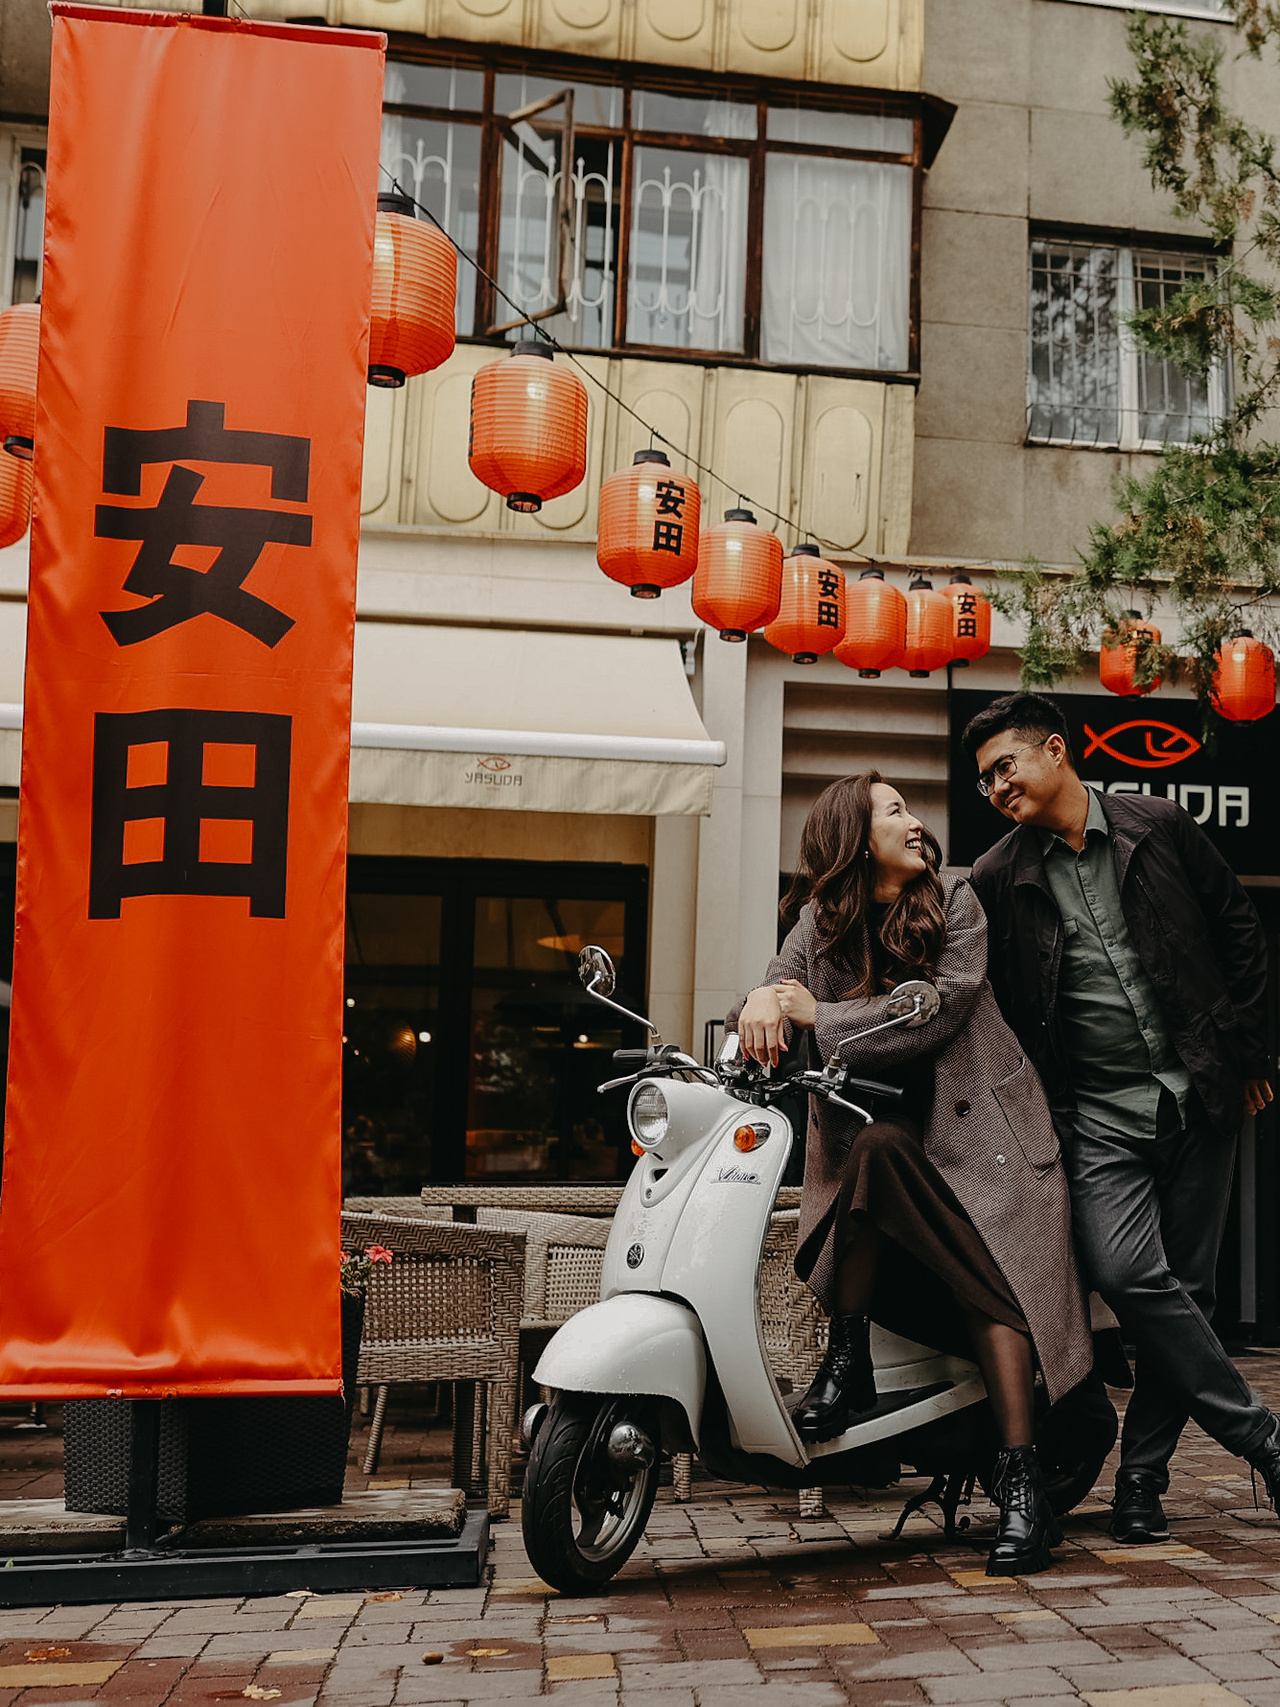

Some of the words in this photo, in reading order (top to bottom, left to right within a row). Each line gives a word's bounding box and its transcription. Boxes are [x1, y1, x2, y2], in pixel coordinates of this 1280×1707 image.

[652, 480, 686, 556] 安田
[817, 569, 840, 630] 安田
[956, 593, 977, 639] 安田
[88, 400, 313, 920] 安田
[464, 772, 523, 787] YASUDA
